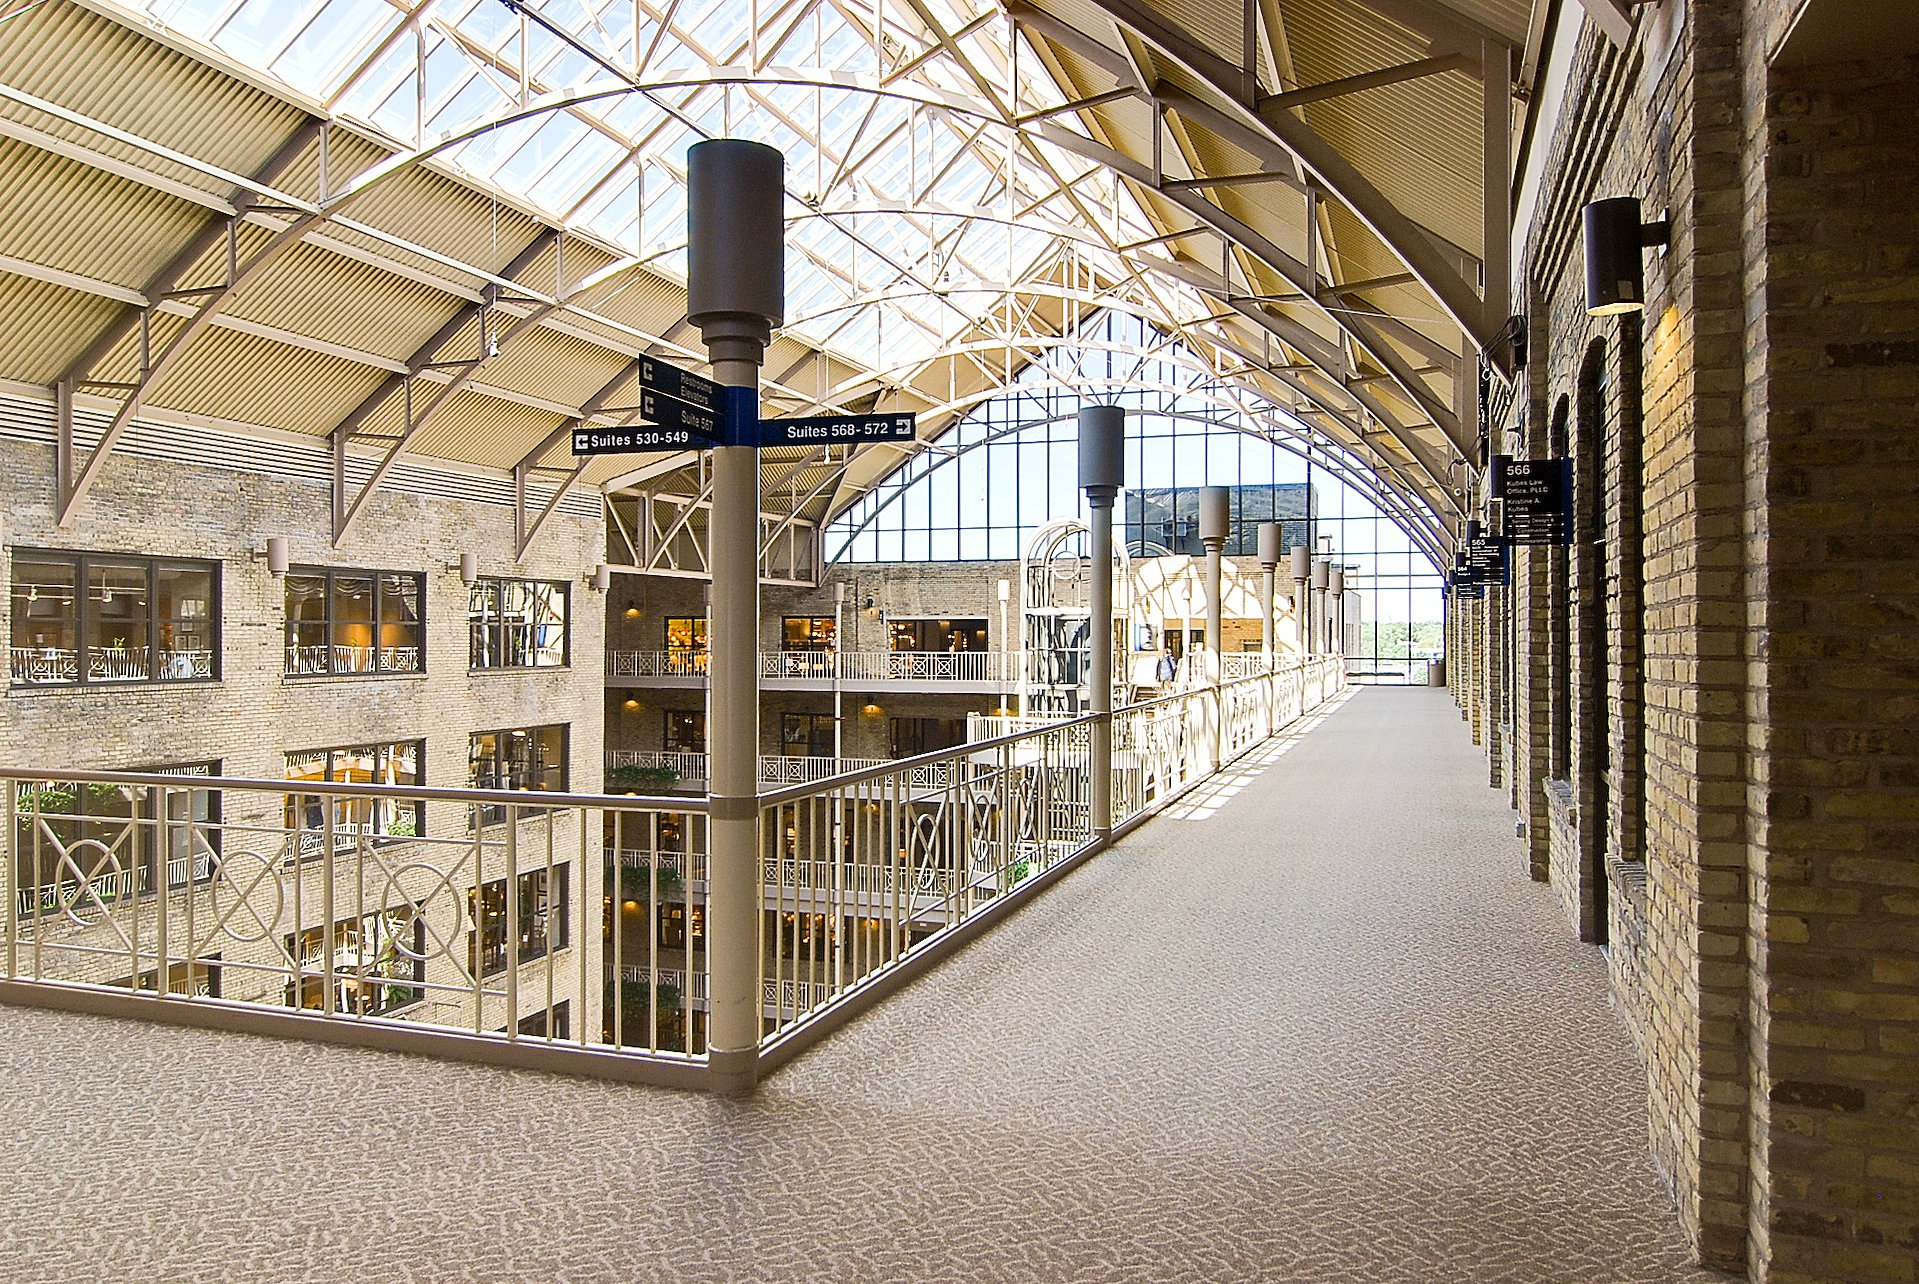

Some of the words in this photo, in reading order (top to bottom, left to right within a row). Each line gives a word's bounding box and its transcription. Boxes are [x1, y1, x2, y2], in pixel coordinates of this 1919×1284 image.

[681, 372, 712, 394] Restrooms
[681, 385, 709, 405] Elevators
[681, 410, 699, 427] Suite
[701, 417, 713, 431] 567
[591, 434, 631, 447] Suites
[636, 431, 689, 444] 530-549
[787, 425, 828, 438] Suites
[864, 422, 888, 435] 572
[1506, 464, 1531, 476] 566
